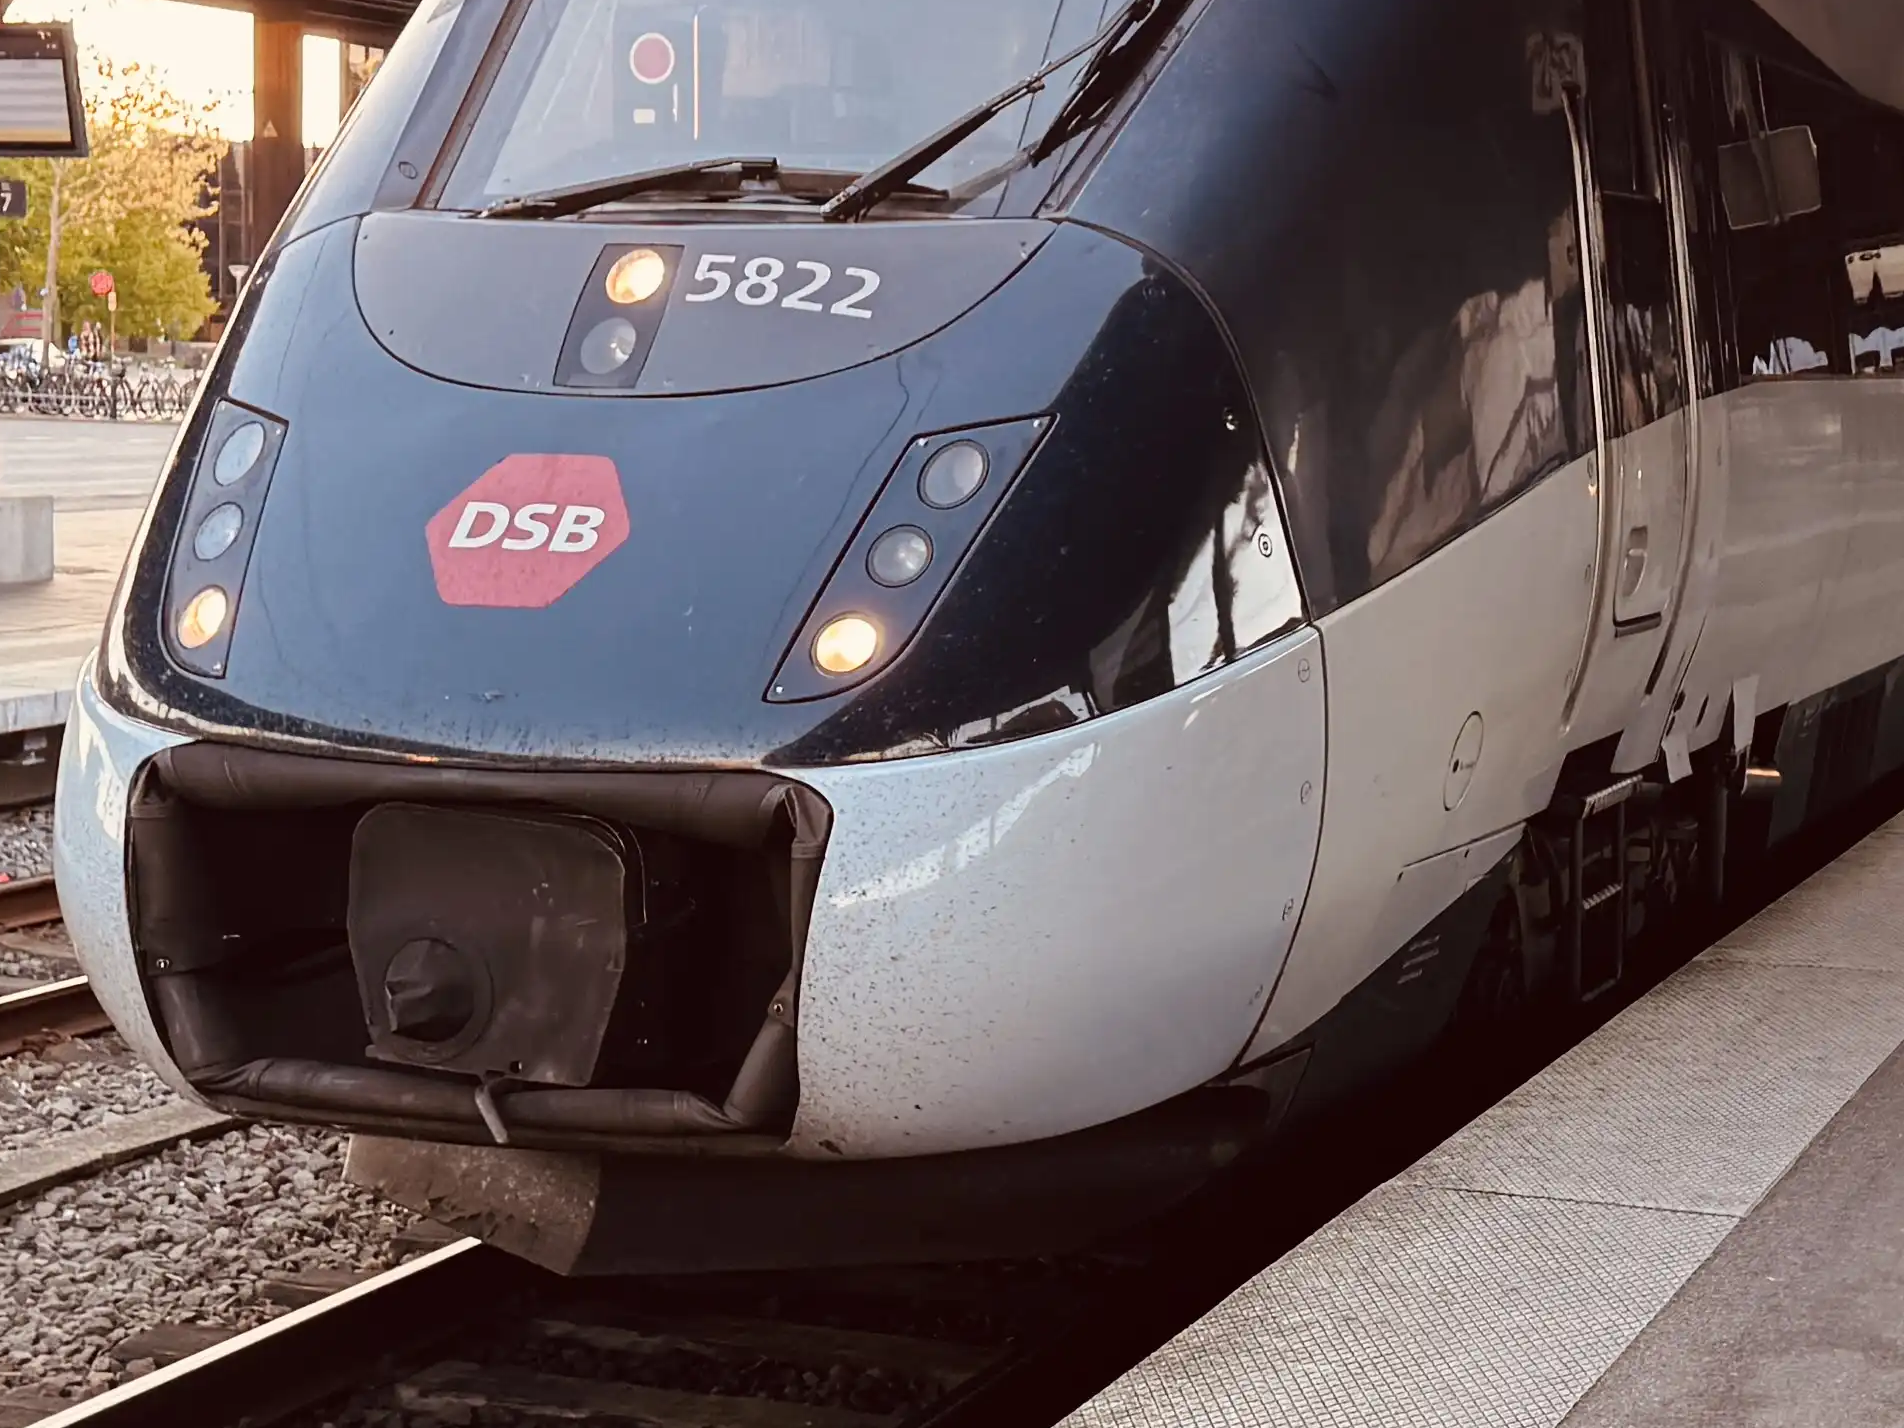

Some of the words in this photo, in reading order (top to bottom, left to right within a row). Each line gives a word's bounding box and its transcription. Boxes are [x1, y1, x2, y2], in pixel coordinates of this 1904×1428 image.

[0, 192, 12, 212] 7
[685, 254, 880, 319] 5822
[448, 501, 605, 553] DSB
